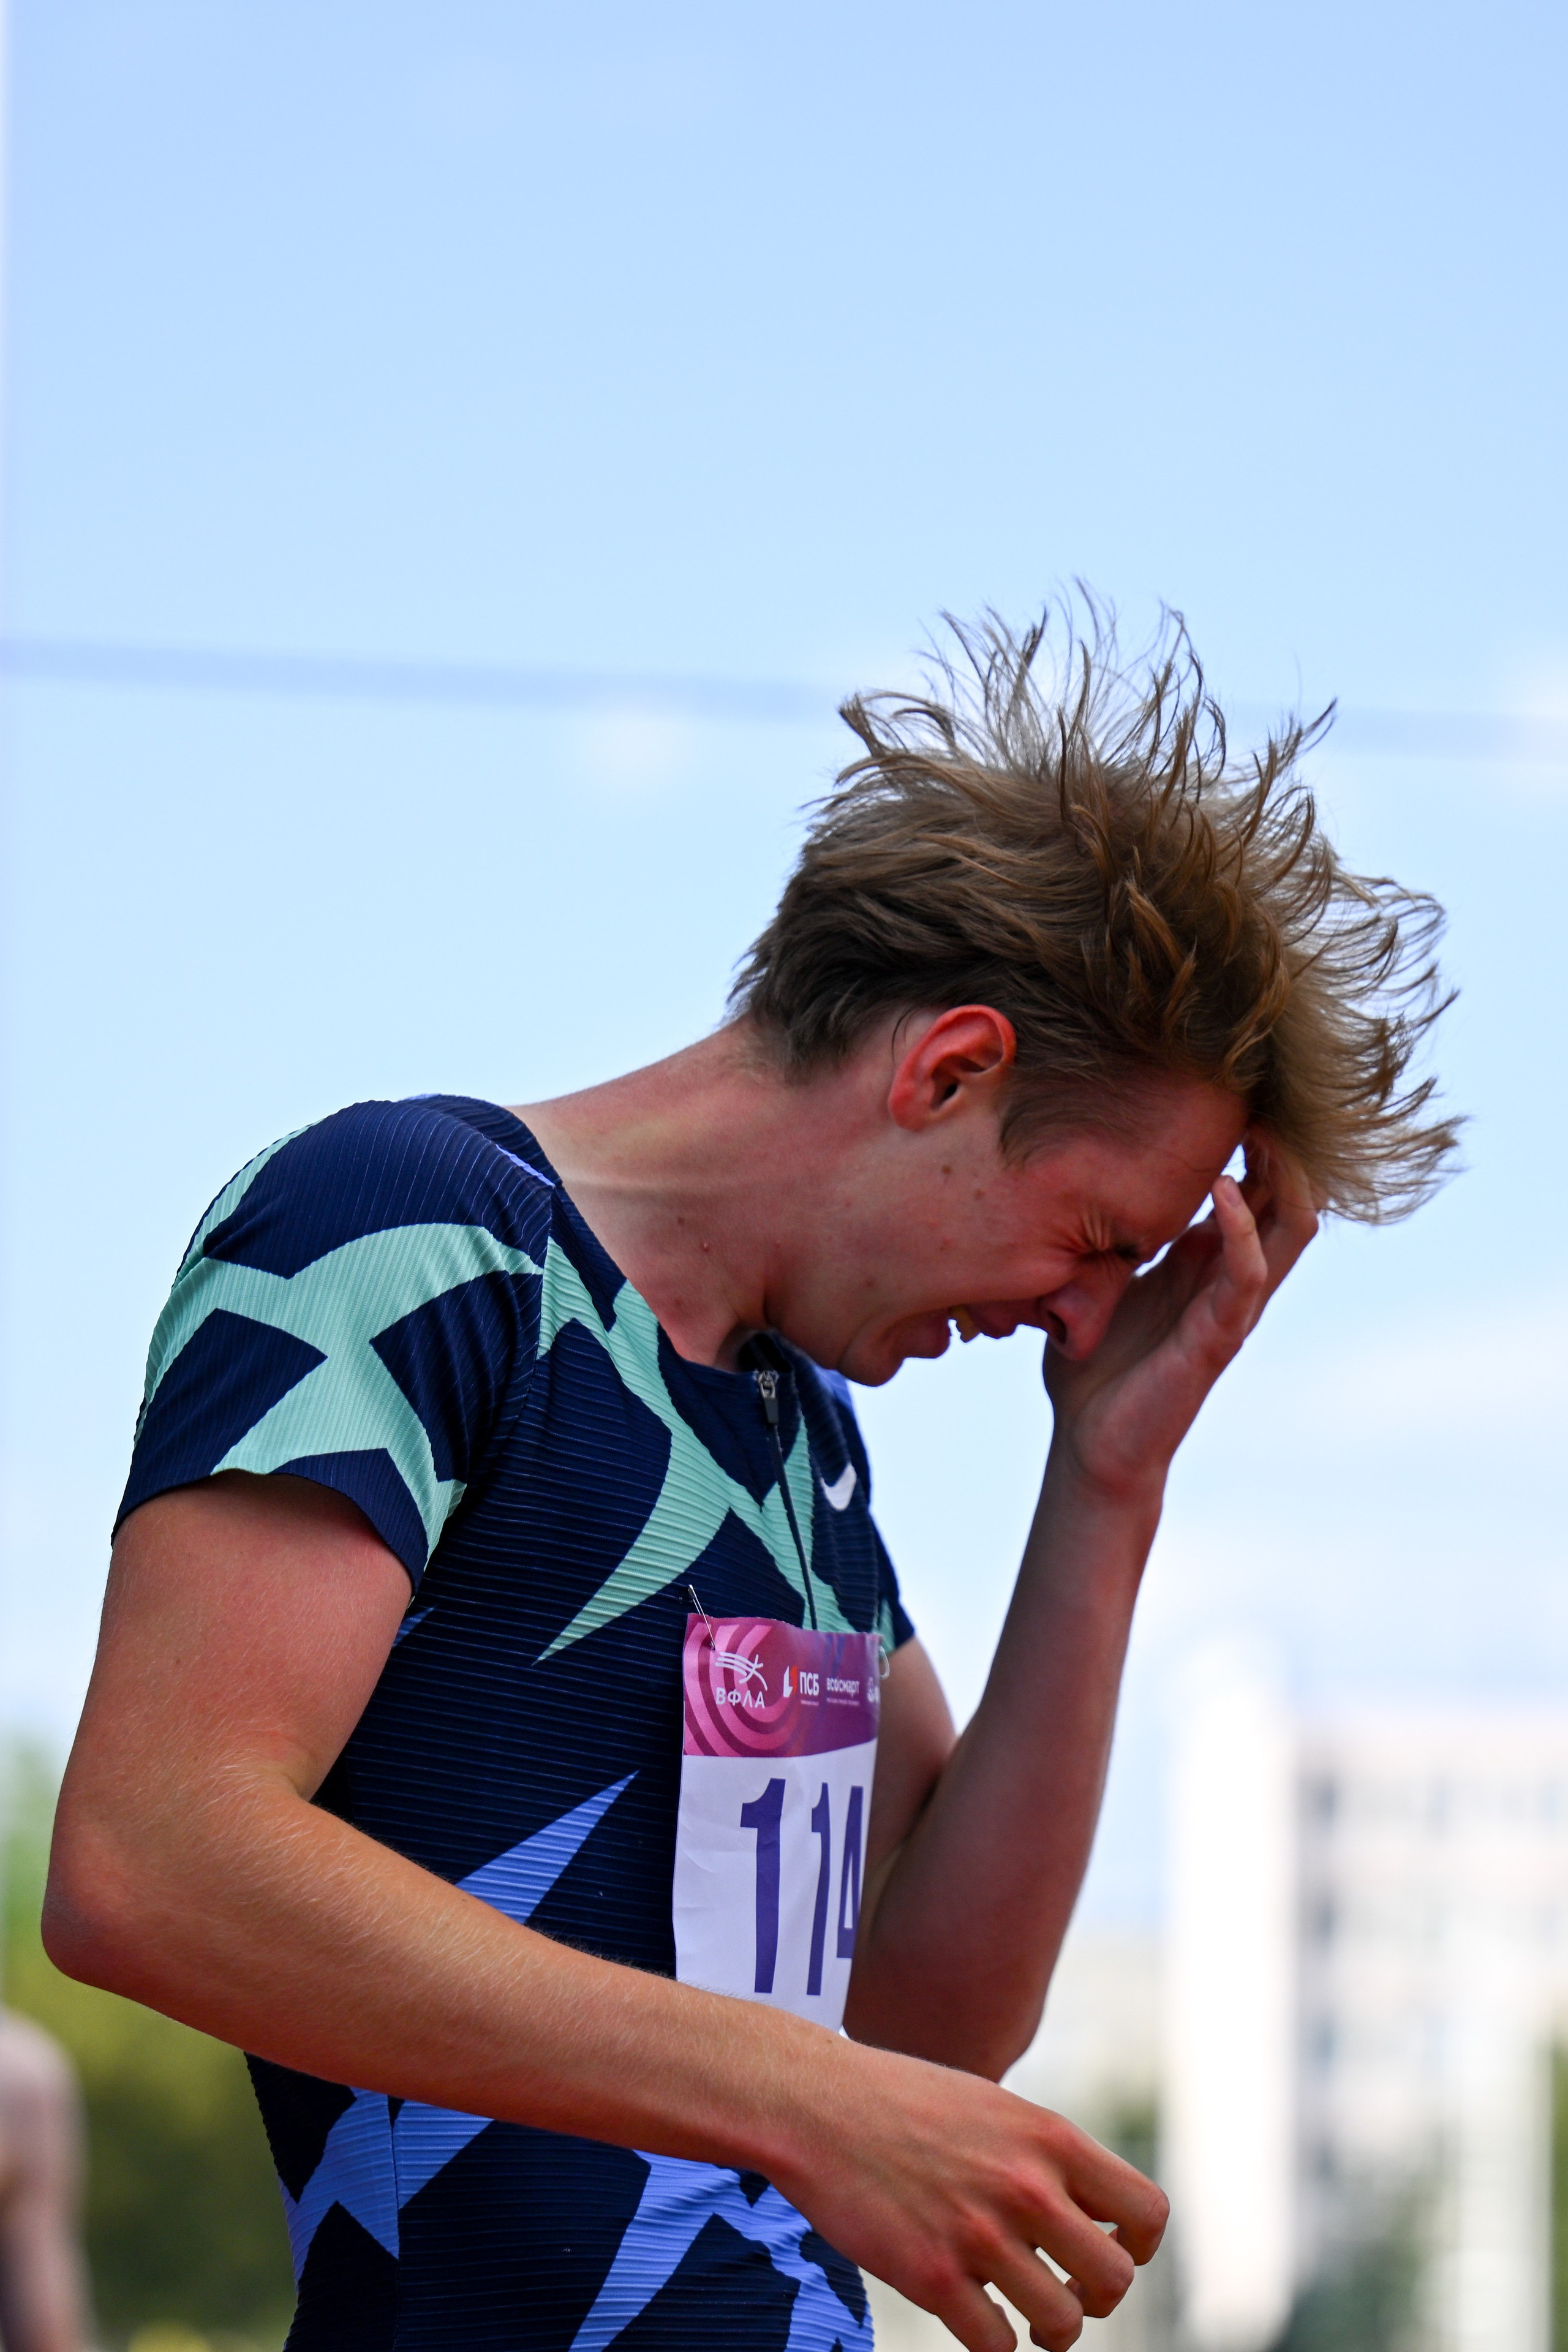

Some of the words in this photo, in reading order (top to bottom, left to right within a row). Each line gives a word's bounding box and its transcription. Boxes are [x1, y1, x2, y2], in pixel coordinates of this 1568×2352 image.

[799, 1671, 820, 1696] ПСБ
[715, 1687, 766, 1709] ВФЛА
[740, 1777, 864, 1996] 114
